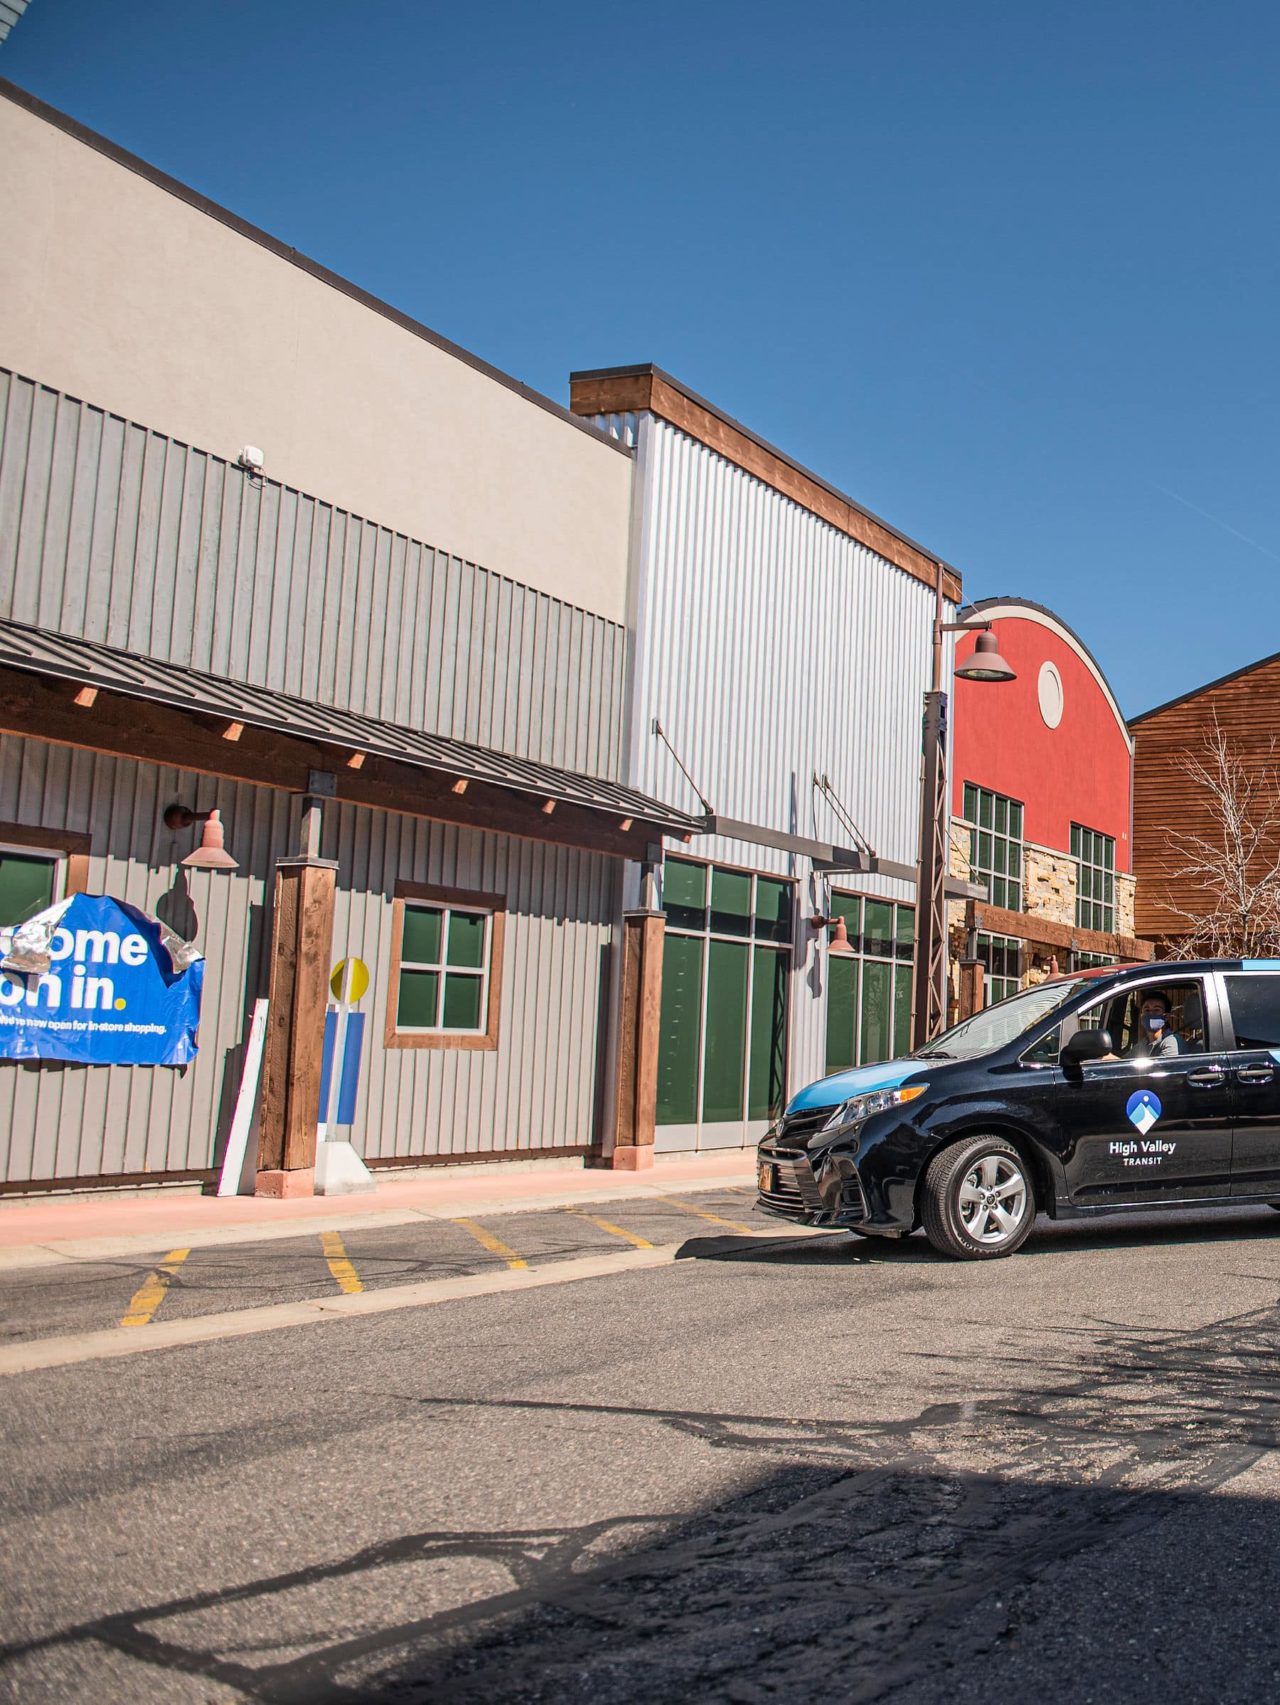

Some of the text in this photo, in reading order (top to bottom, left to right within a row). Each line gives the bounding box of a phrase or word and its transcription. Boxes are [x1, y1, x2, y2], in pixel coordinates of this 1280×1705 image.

[0, 964, 126, 1011] on in.
[26, 1018, 48, 1028] now
[48, 1020, 72, 1031] open
[73, 1020, 88, 1031] for
[88, 1021, 123, 1032] in-store
[124, 1022, 167, 1035] shopping.
[1109, 1140, 1177, 1156] High Valley
[1123, 1157, 1162, 1166] TRANSIT
